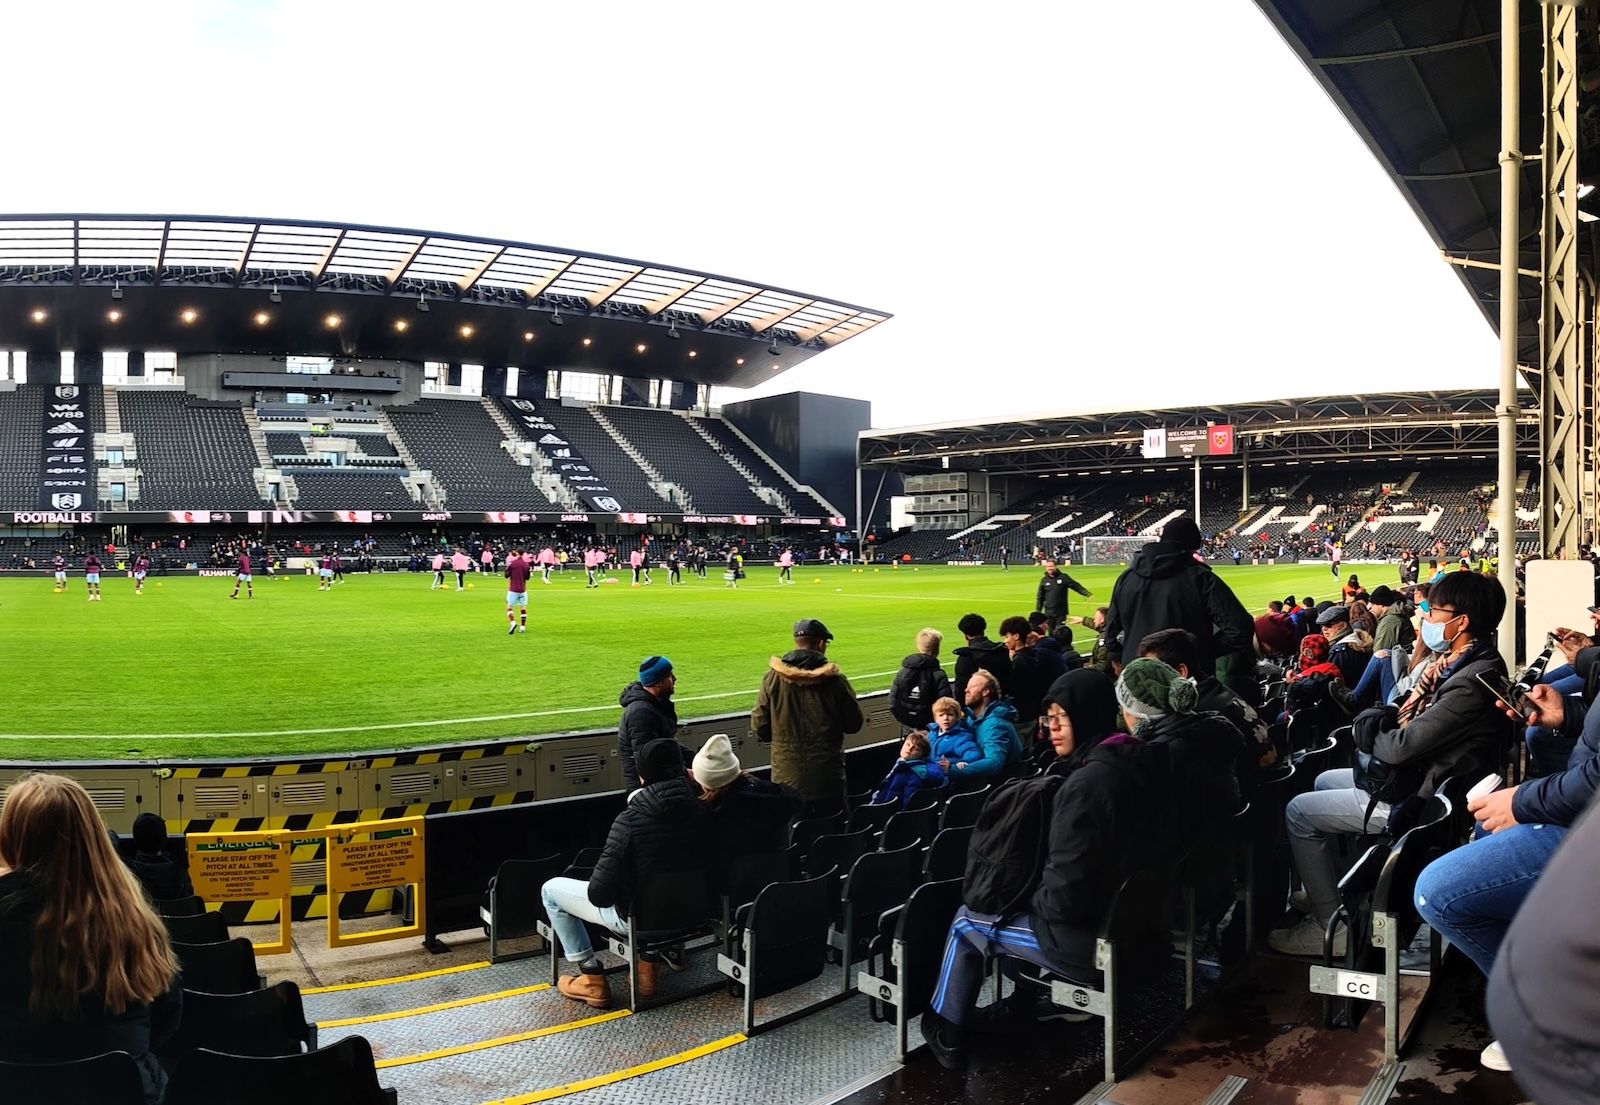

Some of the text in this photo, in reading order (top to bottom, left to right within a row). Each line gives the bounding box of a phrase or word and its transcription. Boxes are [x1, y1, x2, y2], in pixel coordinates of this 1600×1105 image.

[14, 512, 79, 523] FOOTBALL
[81, 512, 92, 523] IS
[1347, 982, 1370, 994] CC
[1074, 992, 1088, 1004] BB
